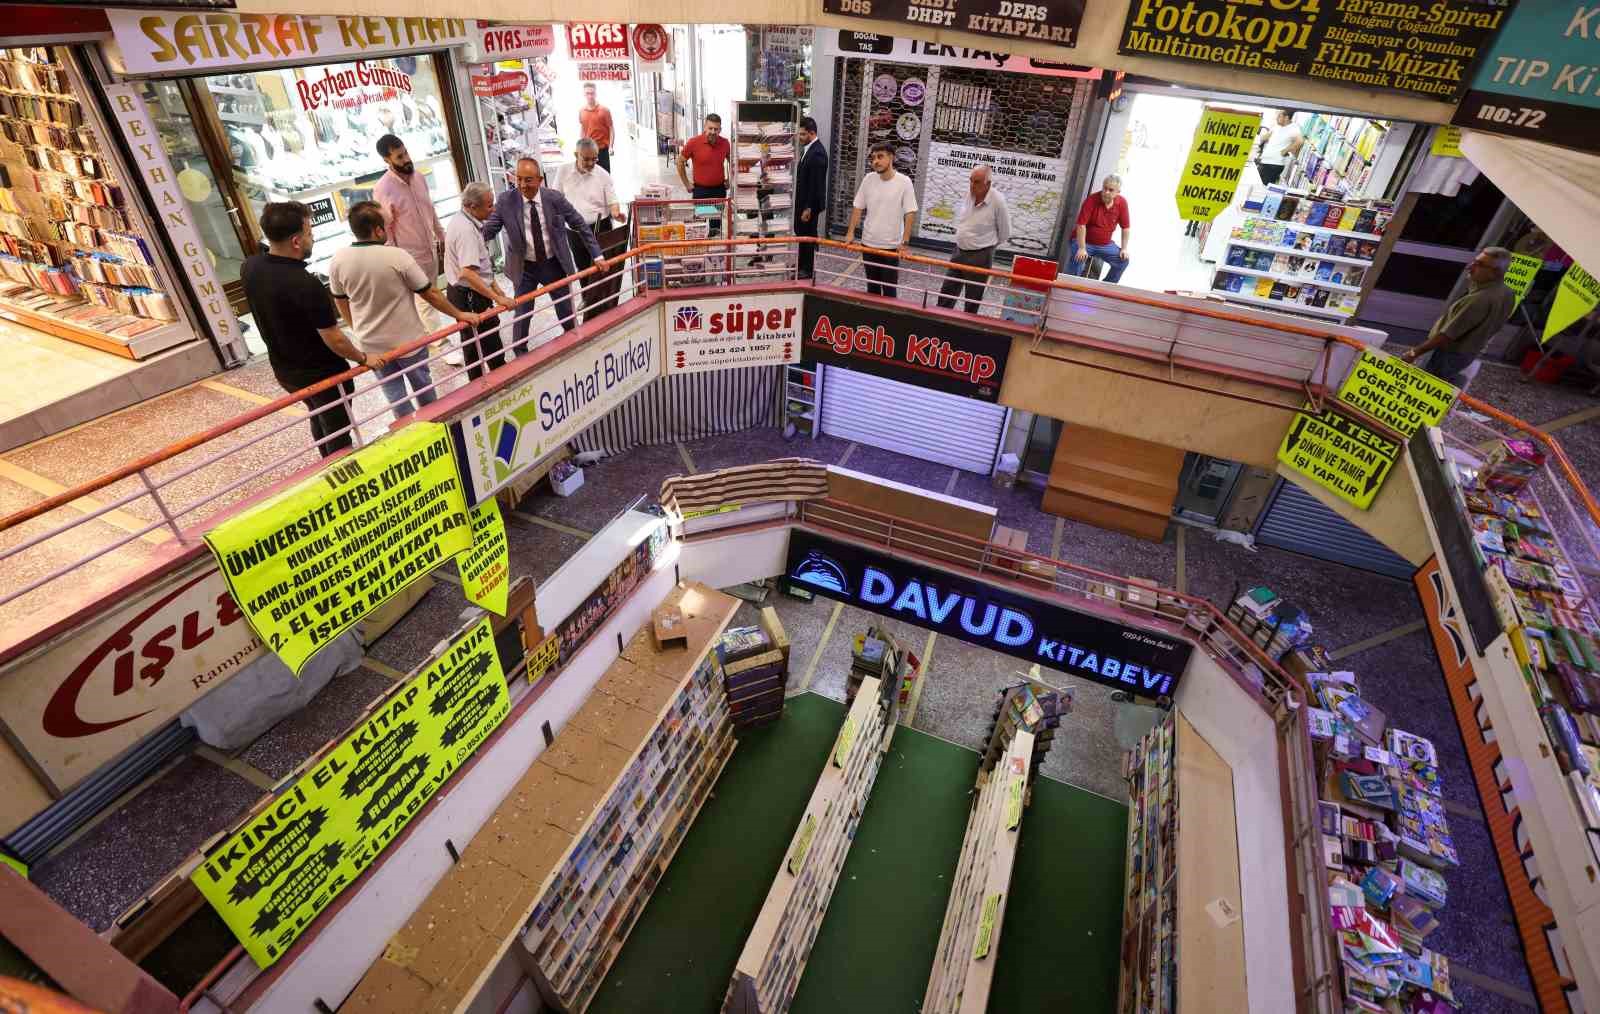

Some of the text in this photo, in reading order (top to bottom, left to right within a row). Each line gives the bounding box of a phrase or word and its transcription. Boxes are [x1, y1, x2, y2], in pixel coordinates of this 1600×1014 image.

[840, 0, 872, 14] DGS
[907, 6, 956, 26] DHBT
[999, 1, 1047, 21] DERS
[1336, 0, 1502, 29] Tarama-Spiral
[1344, 13, 1395, 28] Fotoğraf
[139, 15, 466, 64] SARRAF REYHAN
[484, 30, 522, 53] AYAS
[571, 24, 623, 46] AYAS
[967, 12, 1073, 42] KİTAPLARI
[1133, 0, 1316, 54] Fotokopi
[1325, 26, 1476, 57] Bilgisayar Oyunları
[608, 63, 630, 71] KPSS
[1126, 31, 1300, 73] Multimedia Sahaf
[1314, 42, 1464, 81] Film-Müzik
[296, 68, 358, 111] Reyhan
[1309, 63, 1456, 95] Elektronik Ürünler
[1493, 57, 1549, 86] TIP
[1204, 118, 1255, 139] İKİNCİ EL
[1477, 104, 1546, 128] no:72
[116, 95, 187, 227] REYHAN
[1197, 140, 1240, 157] ALIM
[1192, 163, 1240, 181] SATIM
[311, 200, 328, 211] LTIN
[1182, 185, 1234, 204] NOKTASI
[709, 304, 797, 339] süper
[812, 315, 996, 383] Agâh Kitap
[540, 360, 600, 431] Sahhaf
[604, 336, 652, 390] Burkay
[1357, 368, 1440, 418] ÖĞRETMEN
[1361, 352, 1453, 404] LABORATUVAR
[1359, 385, 1421, 423] ÖNLÜĞÜ
[1306, 421, 1377, 465] BAY-BAYAN
[1325, 452, 1339, 467] VE
[1312, 464, 1359, 497] YAPILIR
[226, 501, 337, 577] ÜNİVERSİTE
[336, 479, 380, 515] DERS
[380, 437, 449, 491] KİTAPLARI
[270, 499, 449, 622] BÖLÜM DERS KİTAPLARI BULUNUR
[467, 544, 506, 582] BULUNUR
[270, 632, 288, 653] 2.
[289, 611, 314, 635] EL
[314, 591, 343, 616] VE
[344, 560, 386, 598] YENİ
[388, 512, 467, 569] KİTAPLAR
[309, 542, 442, 645] İŞLER KİTABEVİ
[860, 566, 1035, 646] DAVUD
[1037, 638, 1172, 694] KİTABEVİ
[202, 783, 307, 883] İKİNCİ
[312, 751, 347, 789] EL
[349, 682, 420, 755] KİTAP
[424, 622, 489, 690] ALINIR
[367, 762, 420, 821] ROMAN
[350, 758, 453, 870] KİTABEVİ
